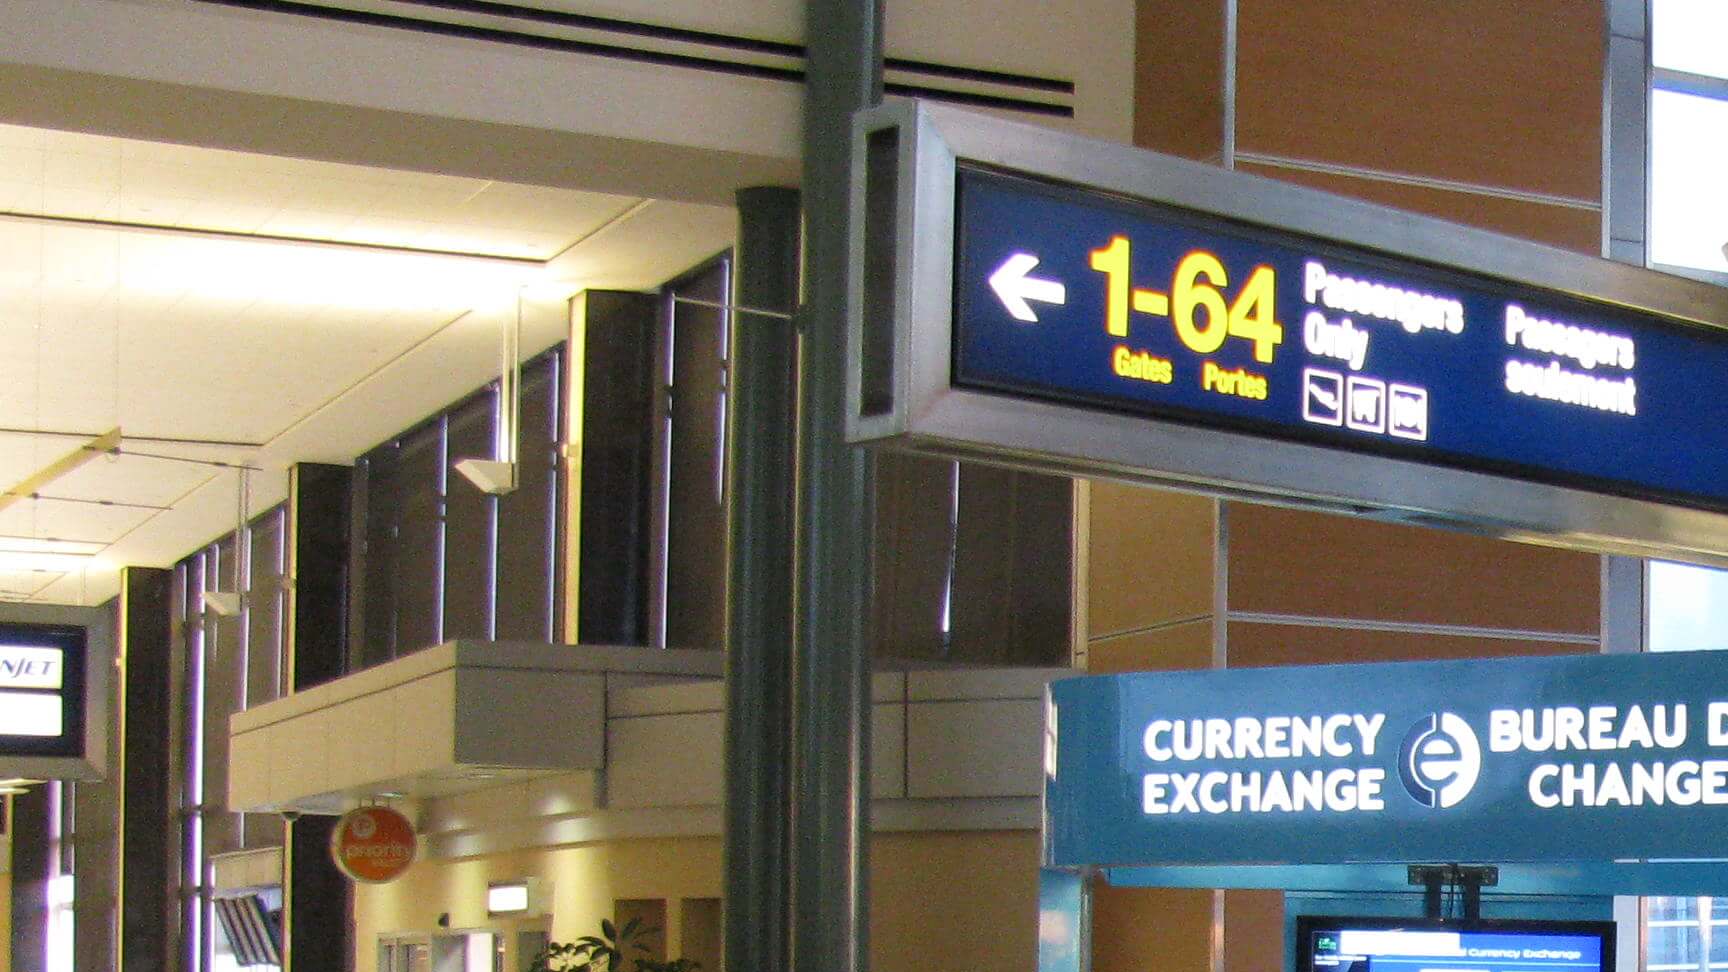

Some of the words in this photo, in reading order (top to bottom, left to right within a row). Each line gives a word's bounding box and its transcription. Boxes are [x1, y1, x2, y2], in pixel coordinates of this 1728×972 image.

[1089, 236, 1283, 364] 1-64
[1303, 261, 1465, 334] Passengers
[1303, 310, 1369, 371] Only
[1504, 303, 1635, 369] Passagers
[1112, 345, 1173, 384] Gates
[1202, 361, 1268, 400] Portes
[1504, 359, 1636, 417] seulement
[1143, 712, 1386, 762] CURRENCY
[1490, 703, 1688, 754] BUREAU
[1143, 768, 1386, 815] EXCHANGE
[1467, 949, 1521, 960] Currency
[1523, 949, 1581, 960] Exchange
